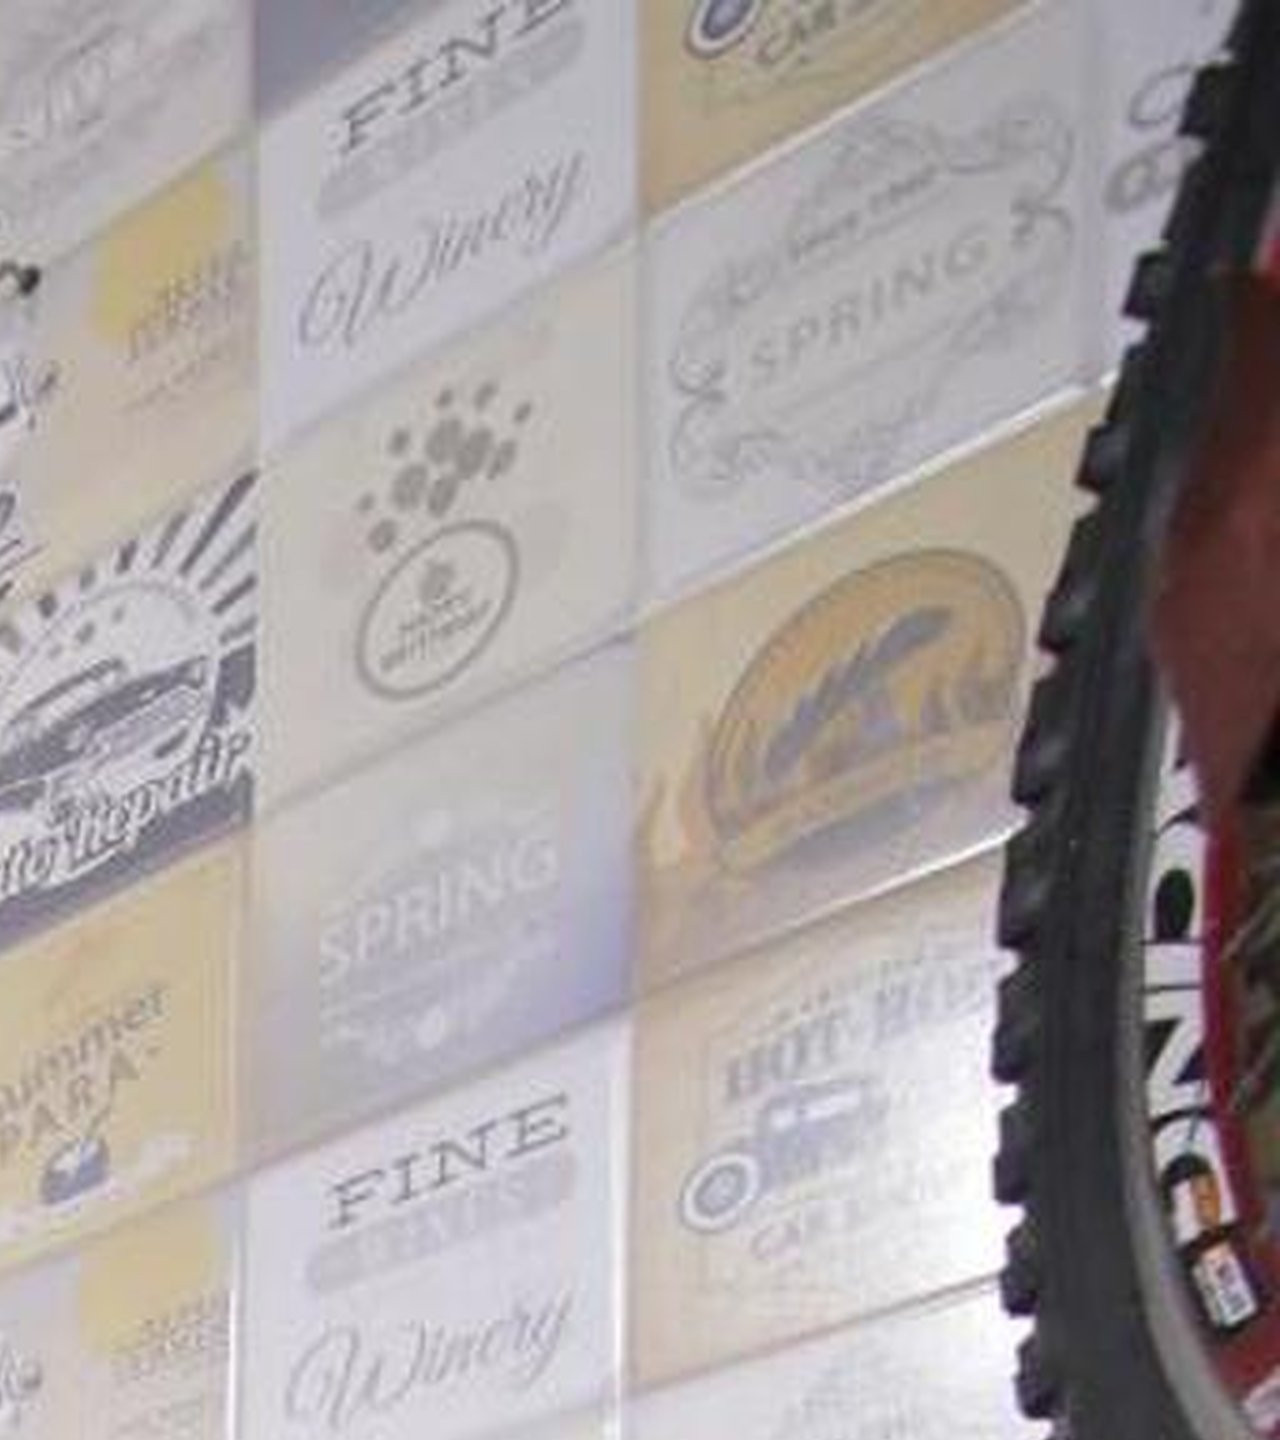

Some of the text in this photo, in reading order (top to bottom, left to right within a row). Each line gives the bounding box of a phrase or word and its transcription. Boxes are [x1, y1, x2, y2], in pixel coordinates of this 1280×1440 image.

[749, 224, 988, 386] SPRING
[319, 835, 558, 985] SPRING
[327, 1094, 569, 1230] FINE
[283, 1294, 573, 1434] Winery
